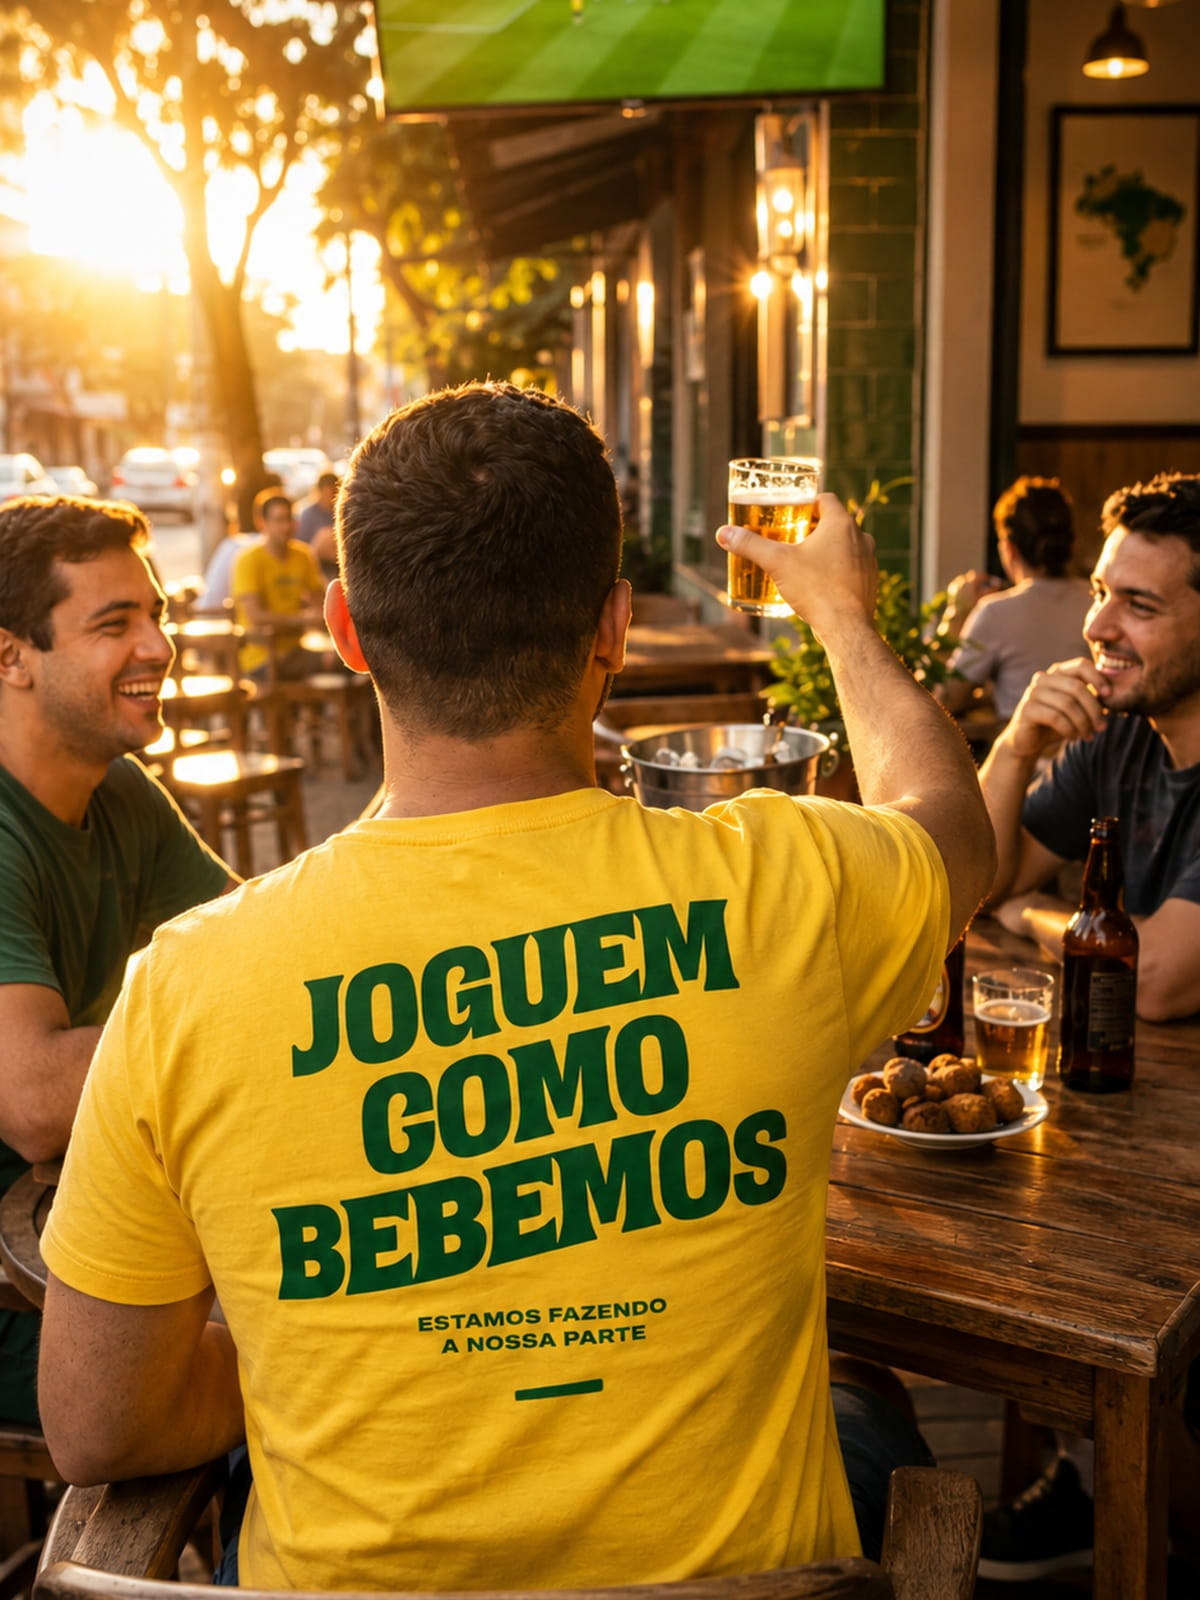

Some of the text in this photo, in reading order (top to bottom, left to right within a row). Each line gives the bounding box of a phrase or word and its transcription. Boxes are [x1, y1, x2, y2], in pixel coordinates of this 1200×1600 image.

[292, 899, 740, 1077] JOGUEM
[362, 1014, 690, 1175] COMO
[271, 1109, 788, 1300] BEBEMOS
[418, 1298, 667, 1332] ESTAMOS FAZENDO
[441, 1325, 646, 1354] A NOSSA PARTE
